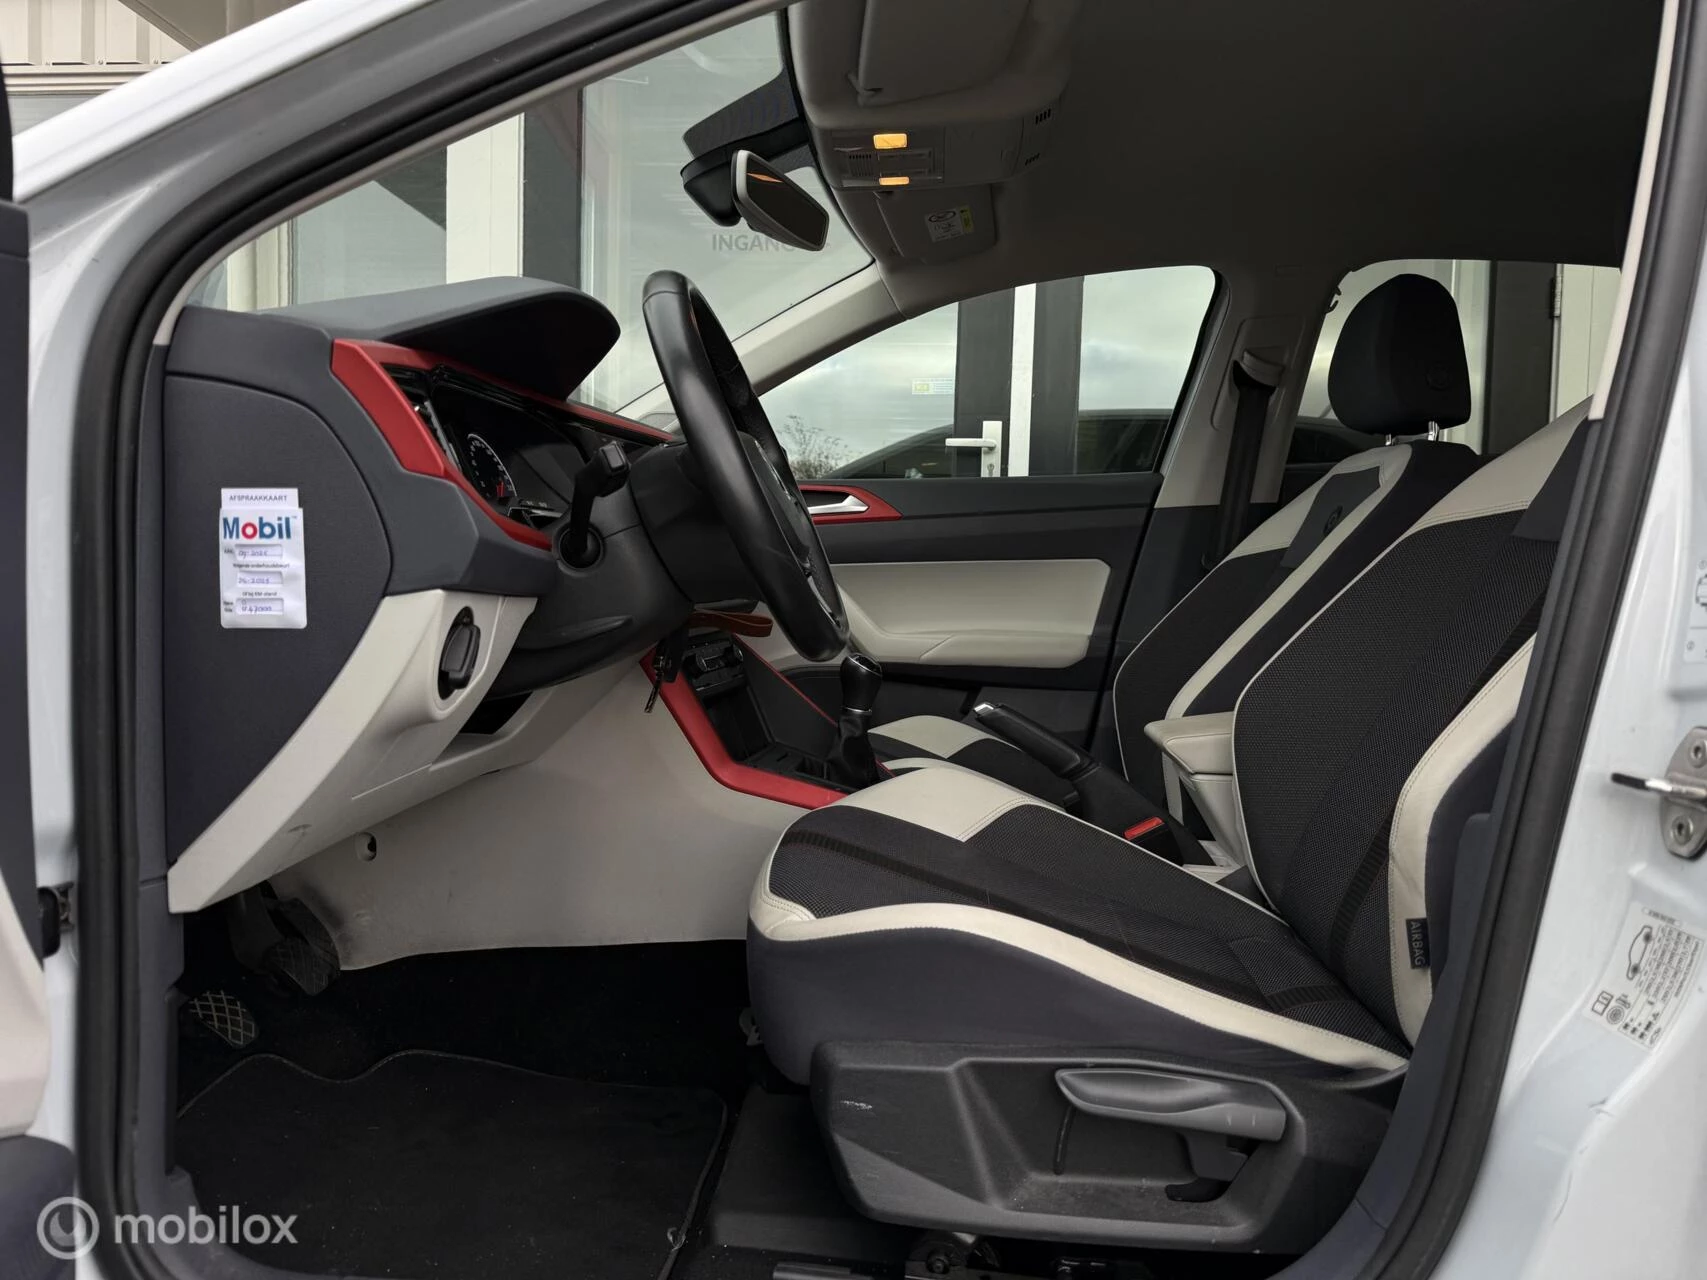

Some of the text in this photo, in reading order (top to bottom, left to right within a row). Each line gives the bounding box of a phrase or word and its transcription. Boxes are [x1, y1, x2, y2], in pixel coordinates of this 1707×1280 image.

[229, 494, 288, 502] AFSPRAAKKAART
[222, 516, 292, 540] Mobil
[1410, 921, 1426, 967] AIRBAG
